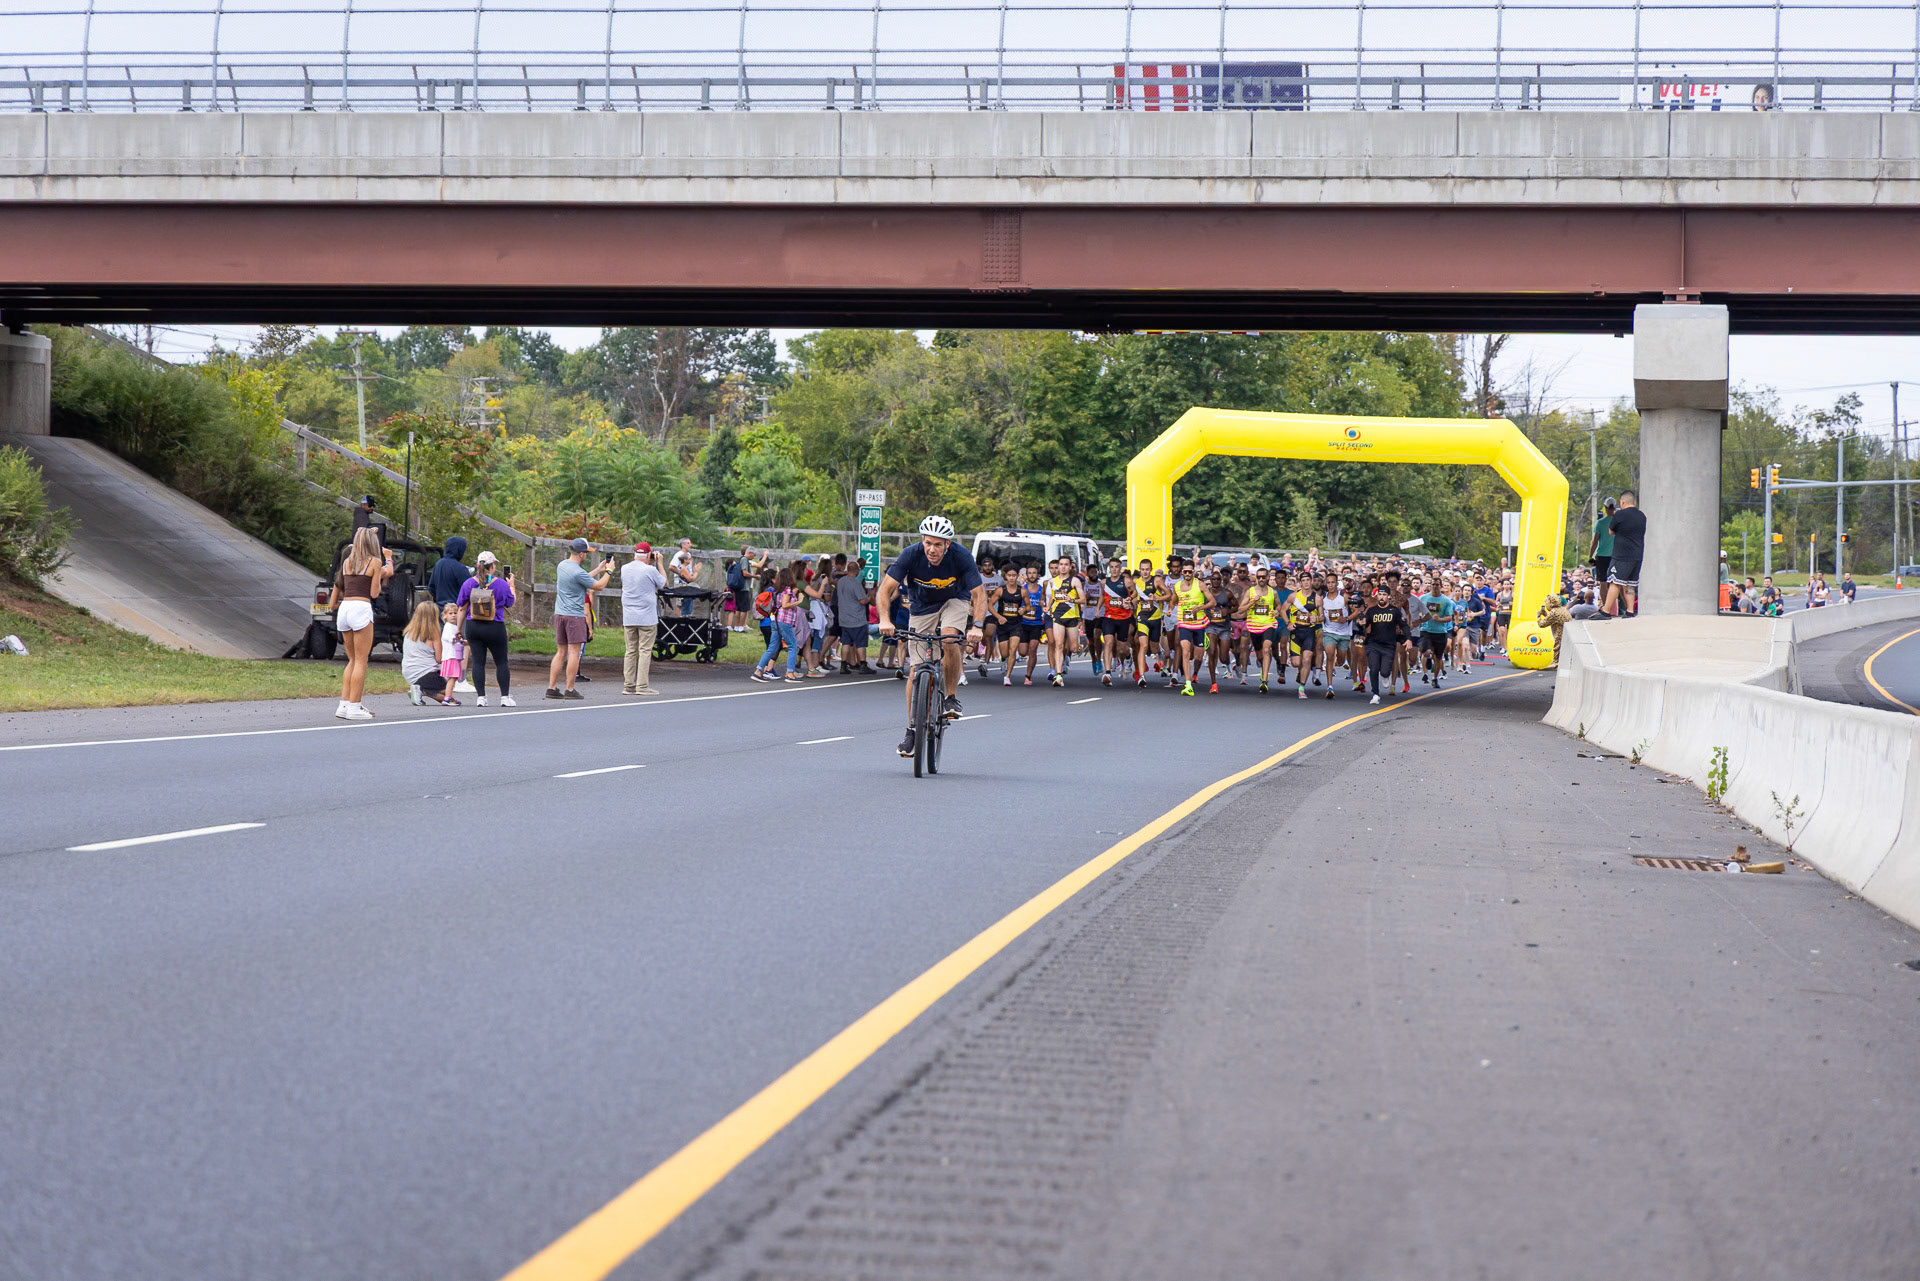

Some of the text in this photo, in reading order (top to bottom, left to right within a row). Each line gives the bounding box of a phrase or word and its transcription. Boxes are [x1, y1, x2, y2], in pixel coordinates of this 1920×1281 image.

[859, 493, 882, 502] BY-PASS
[861, 509, 879, 519] SOUTH
[862, 525, 878, 535] 206
[861, 542, 878, 551] MILE
[866, 553, 873, 564] 2
[867, 568, 874, 580] 6
[1373, 613, 1393, 623] GOOD
